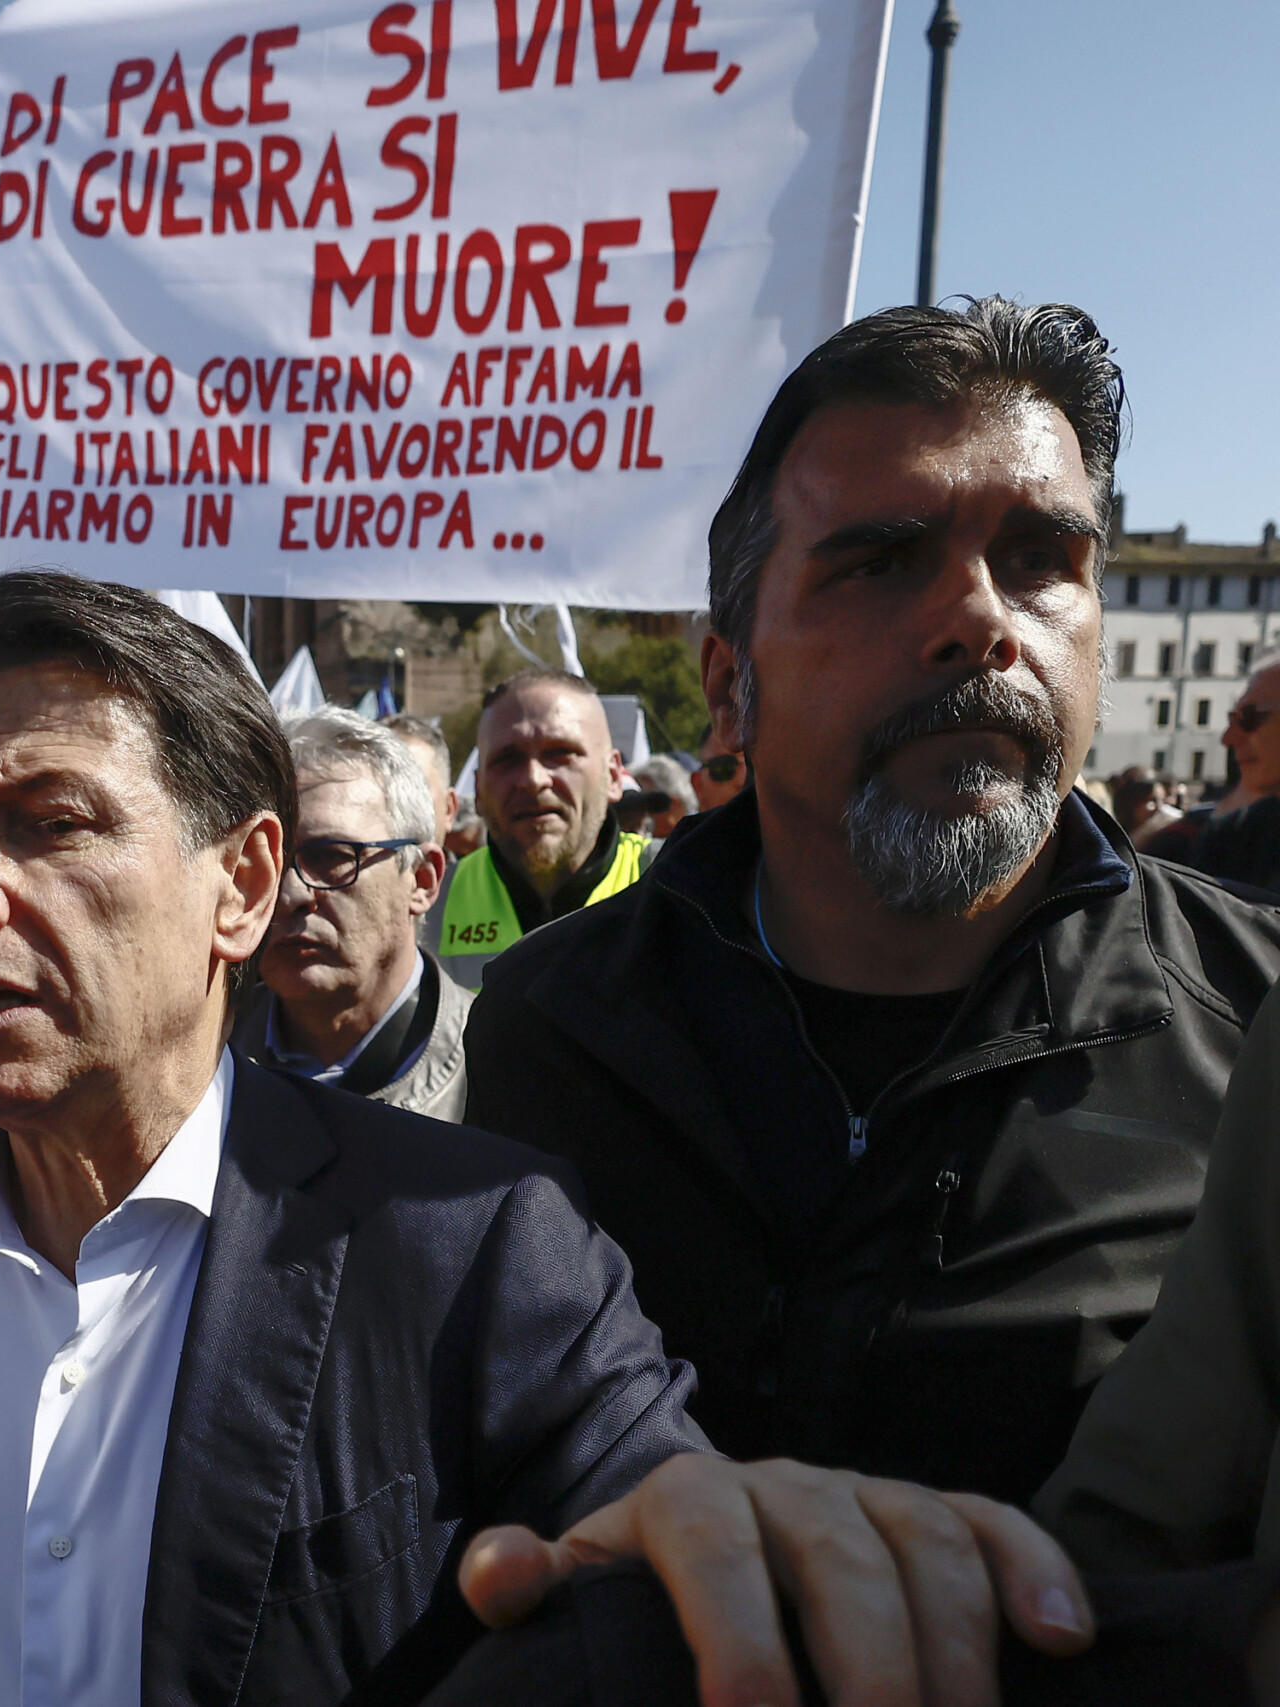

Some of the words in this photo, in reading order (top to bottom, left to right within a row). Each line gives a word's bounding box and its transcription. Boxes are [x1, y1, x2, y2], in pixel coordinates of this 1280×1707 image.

[2, 77, 65, 156] DI
[107, 27, 298, 137] PACE
[366, 0, 452, 107] SI
[495, 0, 742, 95] VIVE,
[74, 135, 353, 237] GUERRA
[373, 113, 457, 221] SI
[198, 353, 412, 419] GOVERNO
[441, 342, 641, 410] AFFAMA
[74, 429, 270, 485] ITALIANI
[301, 409, 606, 484] FAVORENDO
[620, 405, 663, 470] IL
[184, 494, 232, 547] IN
[448, 920, 499, 945] 1455
